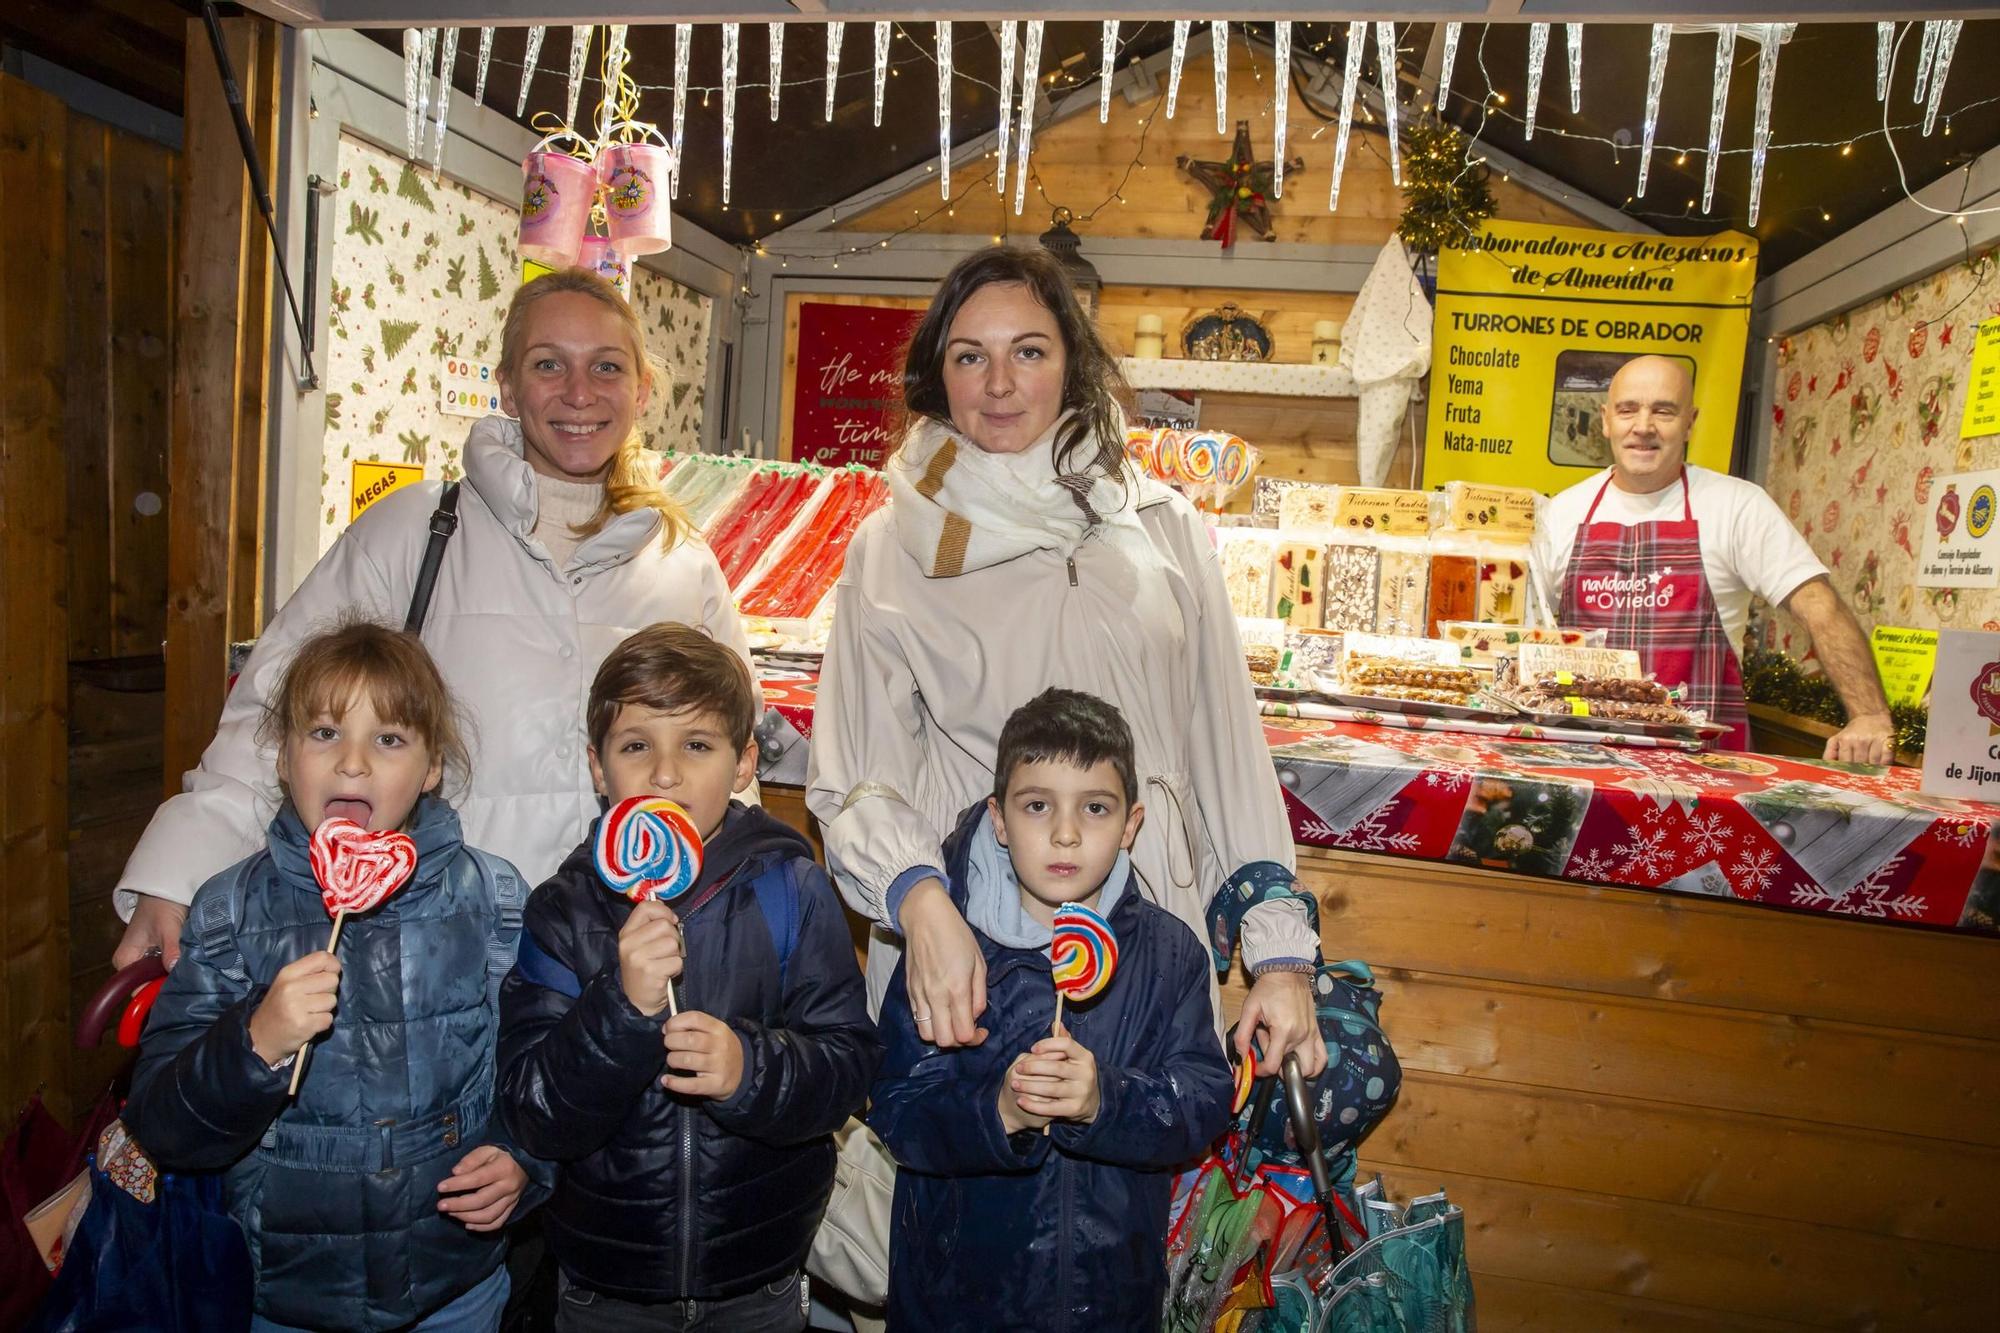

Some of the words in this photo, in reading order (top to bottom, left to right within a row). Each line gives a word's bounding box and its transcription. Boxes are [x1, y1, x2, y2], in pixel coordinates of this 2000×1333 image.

[1613, 241, 1747, 263] Artesanos
[1512, 264, 1541, 285] de
[1545, 266, 1675, 291] Almendra
[1451, 312, 1555, 336] TURRONES
[1561, 318, 1589, 337] DE
[1595, 319, 1703, 343] OBRADOR
[1450, 345, 1520, 369] Chocolate
[820, 352, 862, 395] the
[869, 369, 905, 385] mo
[1448, 373, 1483, 396] Yema
[1445, 402, 1481, 425] Fruta
[816, 447, 841, 460] OF
[849, 448, 883, 461] THE
[1444, 431, 1513, 455] Nata-nuez
[355, 470, 397, 510] MEGAS
[1582, 571, 1648, 593] navidades
[1585, 593, 1596, 605] en
[1597, 591, 1670, 609] Oviedo
[1945, 763, 1963, 779] de
